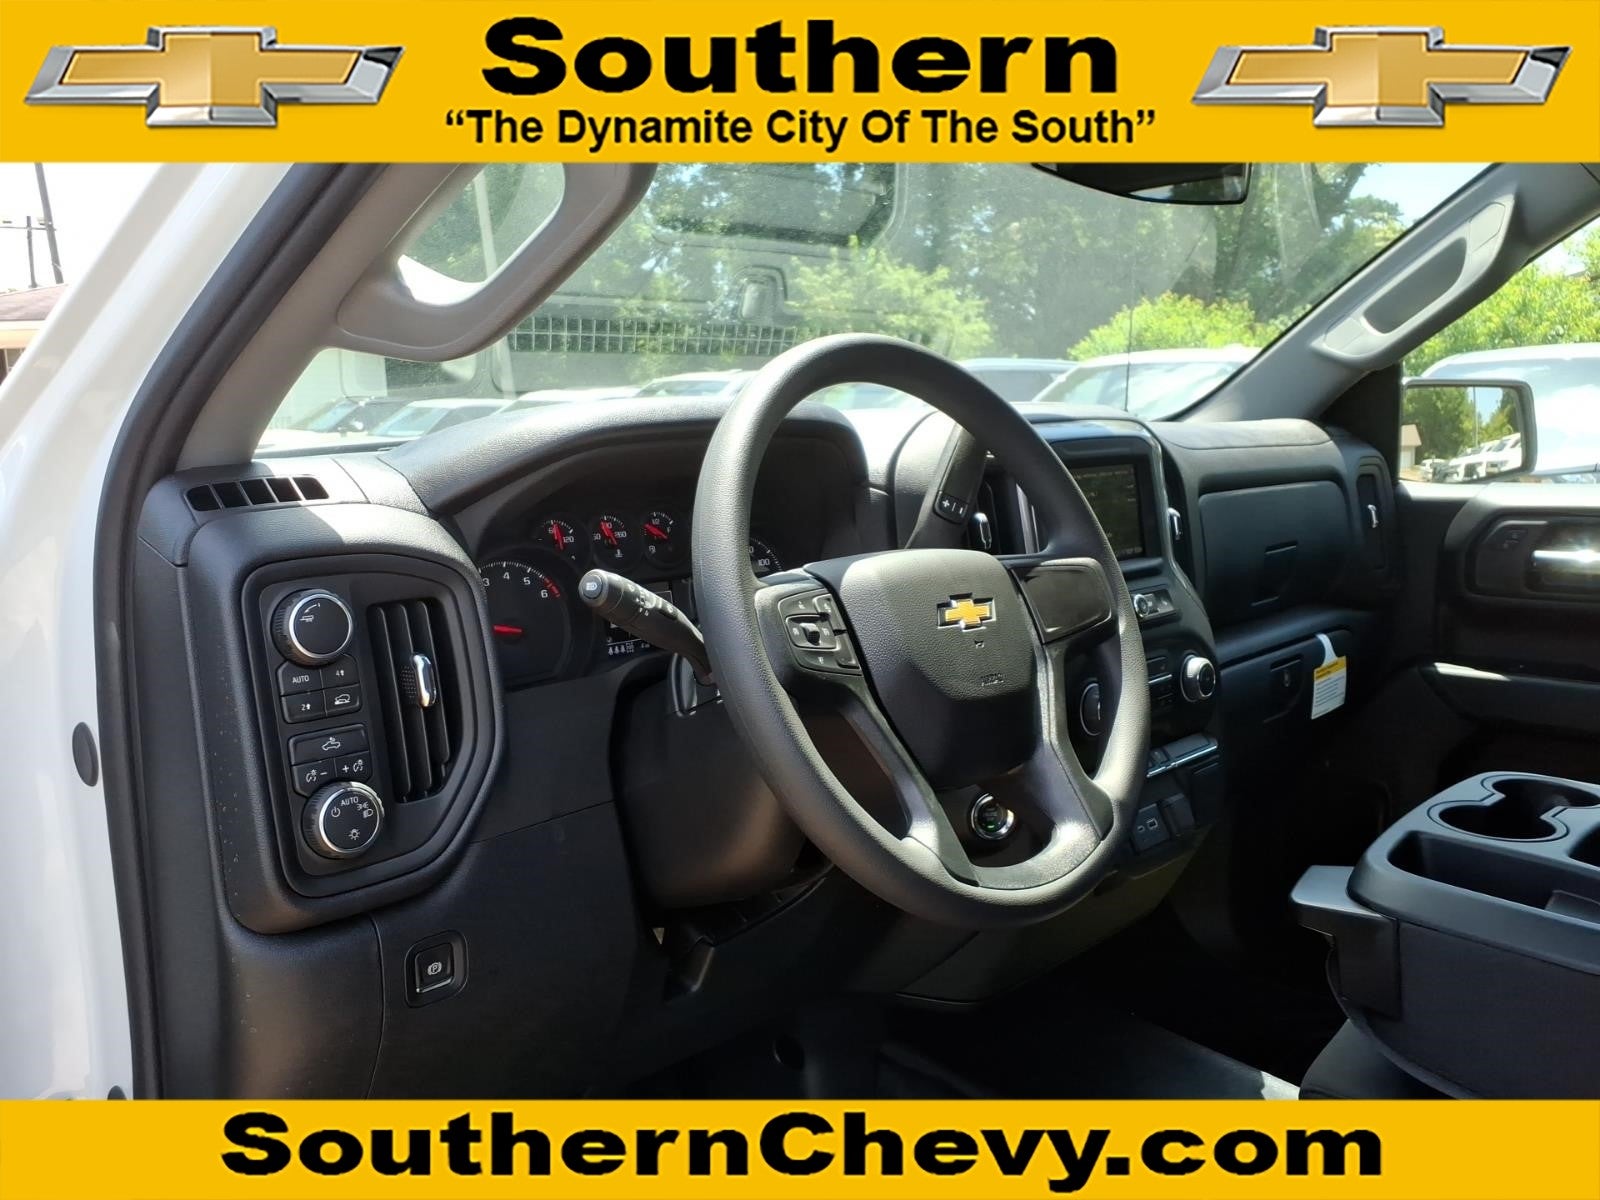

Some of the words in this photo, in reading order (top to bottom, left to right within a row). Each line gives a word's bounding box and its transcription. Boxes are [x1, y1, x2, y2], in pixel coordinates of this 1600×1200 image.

[503, 571, 510, 580] 4
[482, 577, 490, 587] 3
[523, 576, 531, 586] 5
[540, 589, 548, 598] 6
[292, 674, 310, 684] AUTO
[340, 796, 359, 807] AUTO
